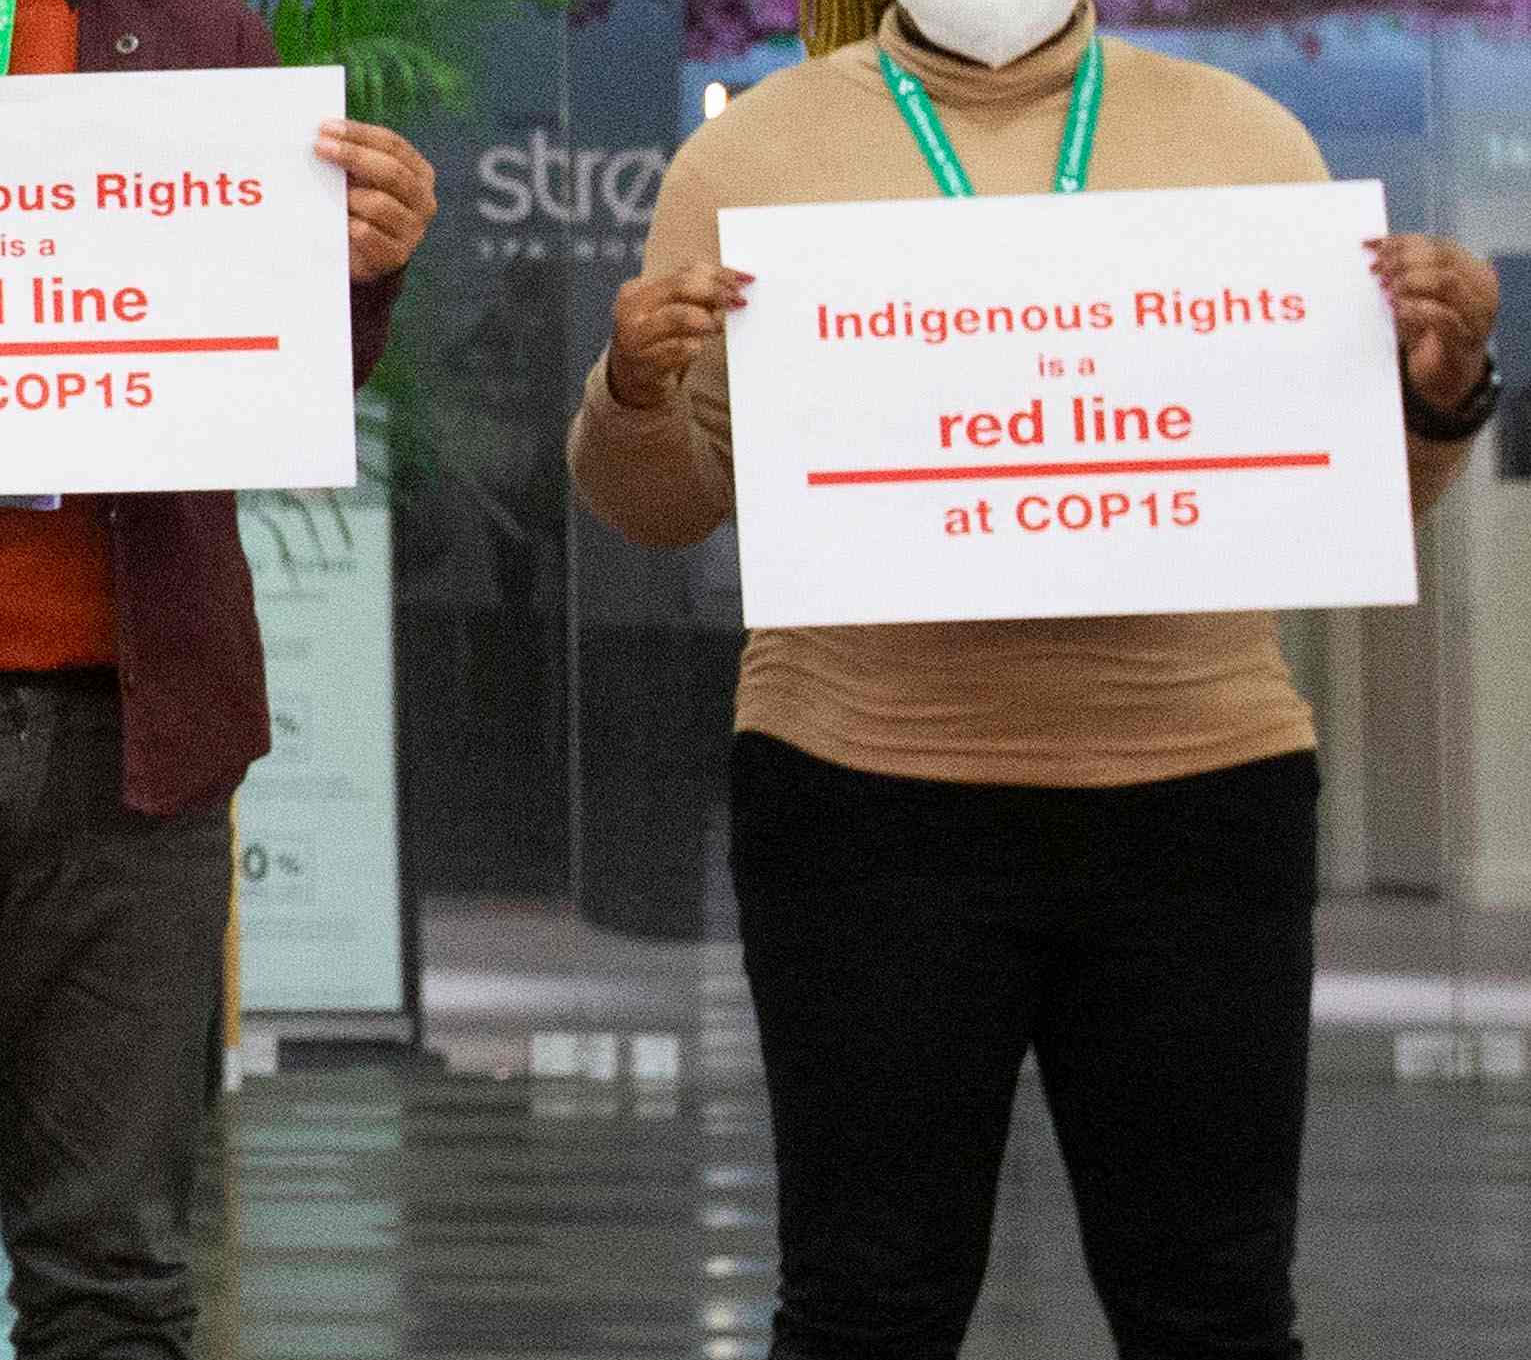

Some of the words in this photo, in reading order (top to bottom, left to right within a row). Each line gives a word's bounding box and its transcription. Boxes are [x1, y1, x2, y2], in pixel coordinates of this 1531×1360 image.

[95, 170, 264, 219] Rights
[0, 233, 27, 258] is
[37, 236, 57, 257] a
[31, 275, 150, 325] line
[816, 301, 1115, 346] Indigenous
[1133, 287, 1307, 336] Rights
[1037, 351, 1066, 377] is
[1076, 354, 1096, 377] a
[937, 398, 1046, 449] red
[1071, 394, 1193, 445] line
[943, 497, 994, 537] at
[1014, 488, 1201, 534] COP15
